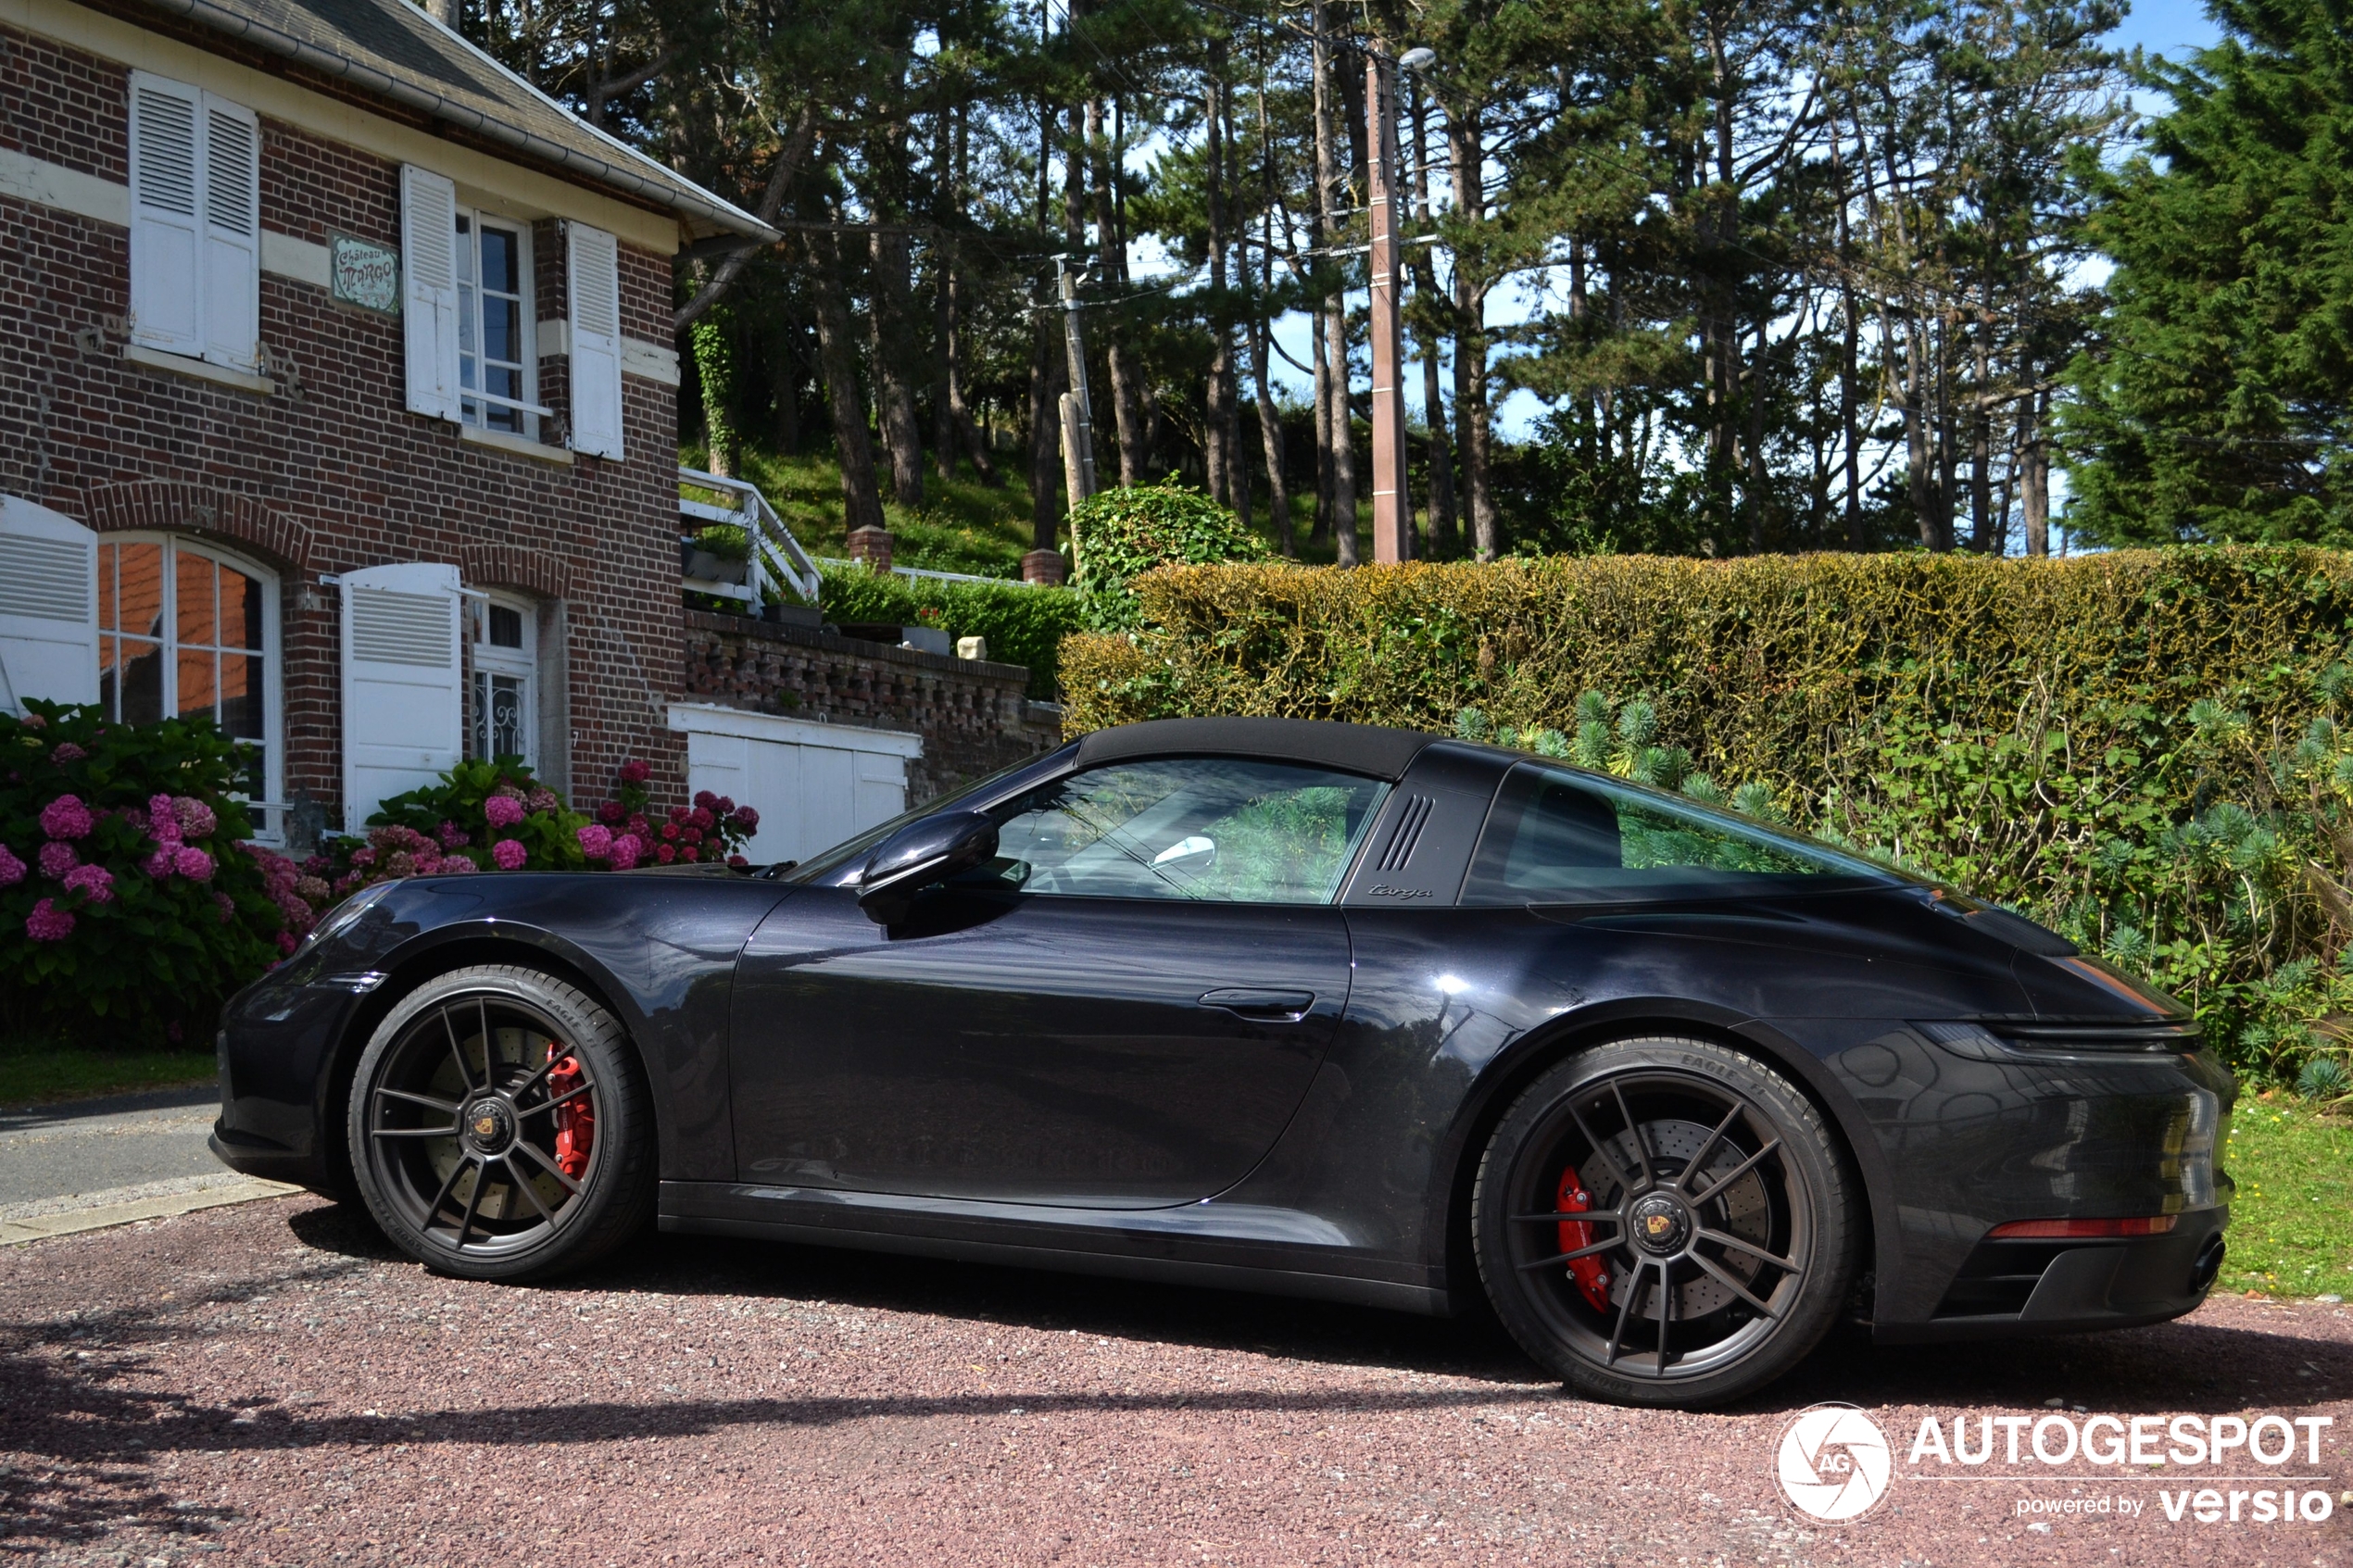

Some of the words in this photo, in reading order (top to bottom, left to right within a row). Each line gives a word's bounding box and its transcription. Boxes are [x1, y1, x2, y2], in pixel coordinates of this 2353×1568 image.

[338, 248, 381, 266] Château
[1368, 884, 1434, 901] targa
[546, 999, 582, 1030] EAGLE
[1680, 1054, 1738, 1081] EAGLE
[560, 1089, 571, 1144] PRSCHE
